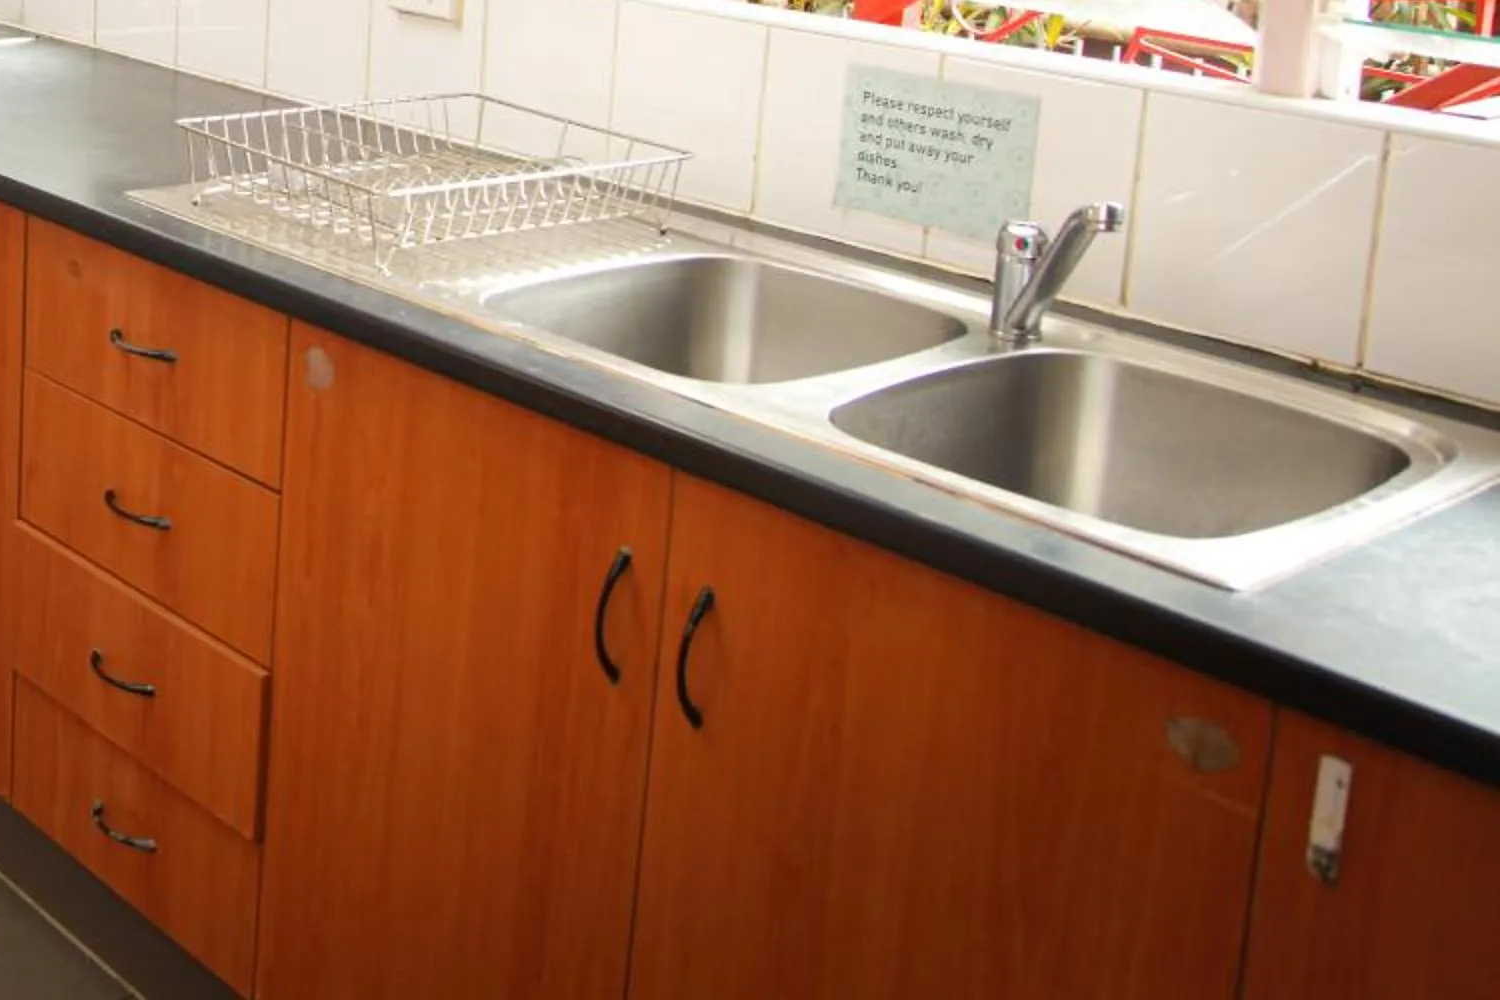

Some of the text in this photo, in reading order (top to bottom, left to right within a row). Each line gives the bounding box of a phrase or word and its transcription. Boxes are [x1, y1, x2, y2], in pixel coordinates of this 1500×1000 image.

[863, 91, 1013, 132] Please respect yourself
[859, 132, 976, 165] and put away your
[860, 112, 884, 127] and
[887, 116, 927, 135] others
[971, 133, 995, 152] dry
[856, 167, 893, 187] Thank
